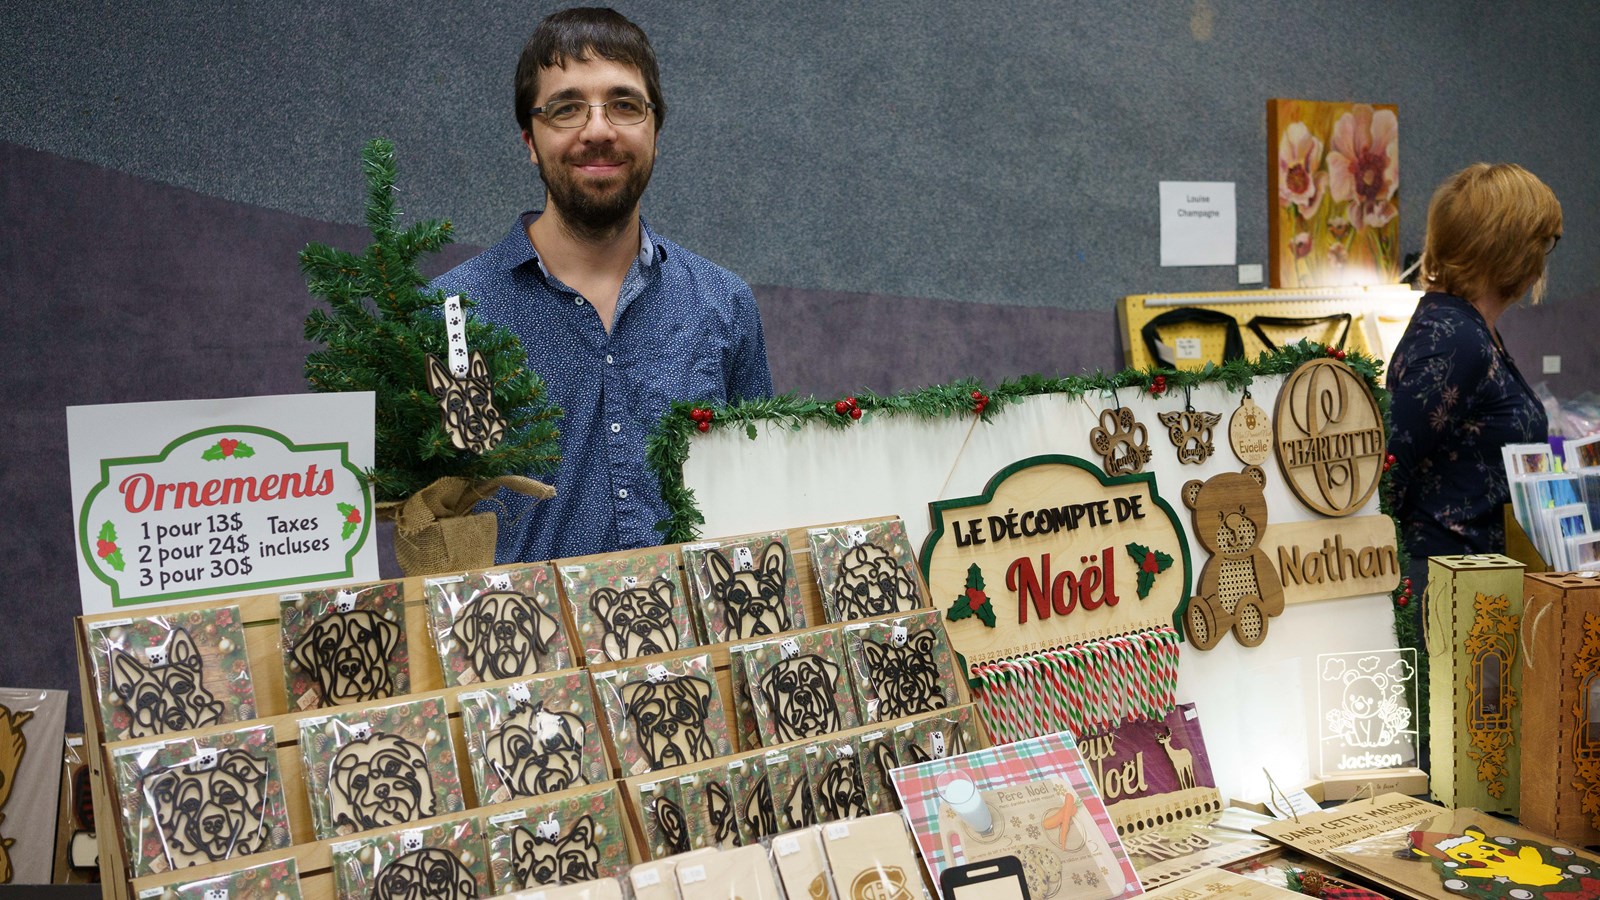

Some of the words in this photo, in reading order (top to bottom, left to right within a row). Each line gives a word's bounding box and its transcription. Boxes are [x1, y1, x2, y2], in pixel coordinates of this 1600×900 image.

[1177, 209, 1220, 219] Champagne
[1186, 194, 1210, 204] Louise
[1239, 440, 1268, 454] Evaëlle
[1282, 428, 1383, 466] CHARLOTTE
[118, 464, 334, 514] Ornements
[140, 522, 151, 540] 1
[156, 522, 203, 544] pour
[207, 512, 244, 533] 13$
[267, 516, 319, 535] Taxes
[952, 518, 987, 548] LE
[988, 500, 1113, 543] DÉCOMPTE
[1113, 494, 1146, 523] DE
[138, 546, 152, 564] 2
[158, 544, 204, 567] pour
[209, 534, 250, 556] 24$
[260, 536, 330, 558] incluses
[1278, 534, 1398, 588] Nathan
[139, 568, 153, 587] 3
[160, 566, 205, 591] pour
[210, 556, 254, 579] 30$
[1006, 546, 1120, 626] Noël
[1337, 751, 1403, 770] Jackson
[1279, 826, 1322, 842] DANS
[1321, 814, 1367, 830] CETTE
[1366, 800, 1424, 818] MAISON
[1348, 823, 1377, 836] toute
